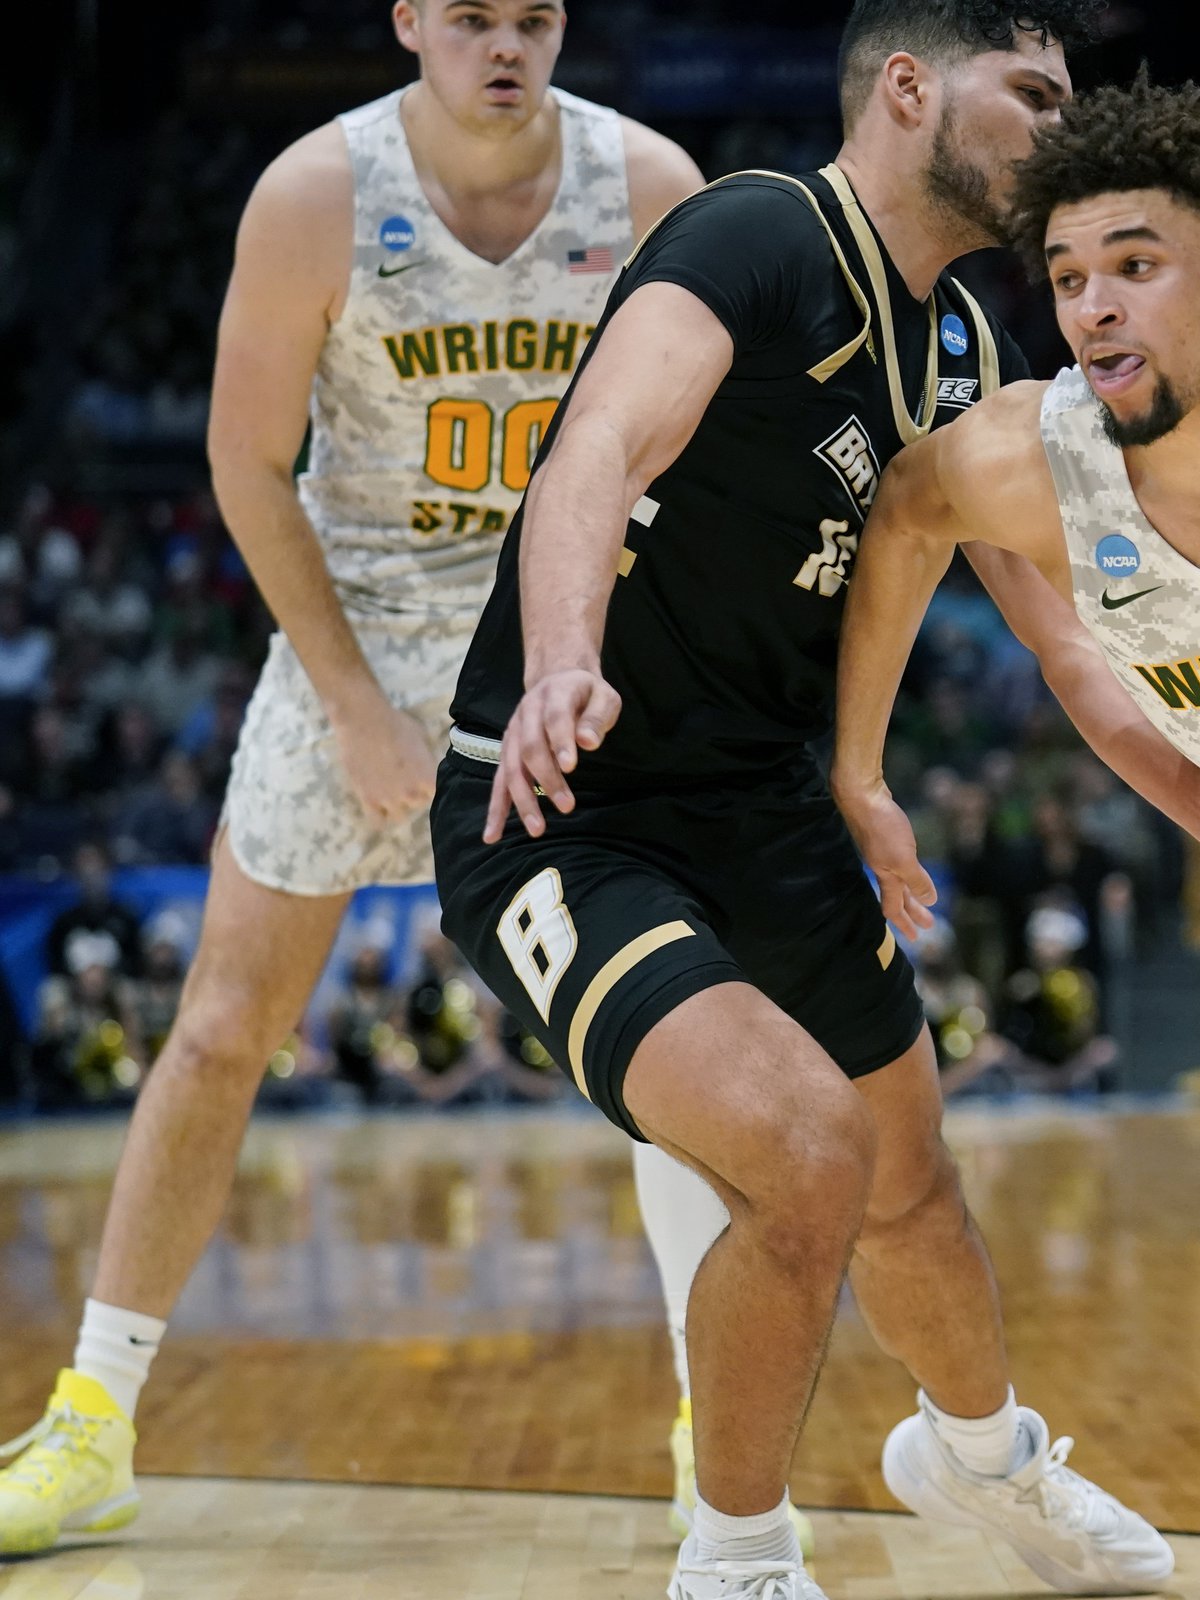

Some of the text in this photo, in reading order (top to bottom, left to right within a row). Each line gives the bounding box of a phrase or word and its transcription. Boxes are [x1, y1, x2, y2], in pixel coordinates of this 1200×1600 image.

[381, 319, 598, 379] WRIGH
[944, 329, 968, 349] NCAA
[936, 380, 977, 399] EC
[423, 396, 563, 492] 00
[410, 501, 507, 534] STA
[1102, 555, 1138, 569] NCAA
[496, 867, 578, 1027] B
